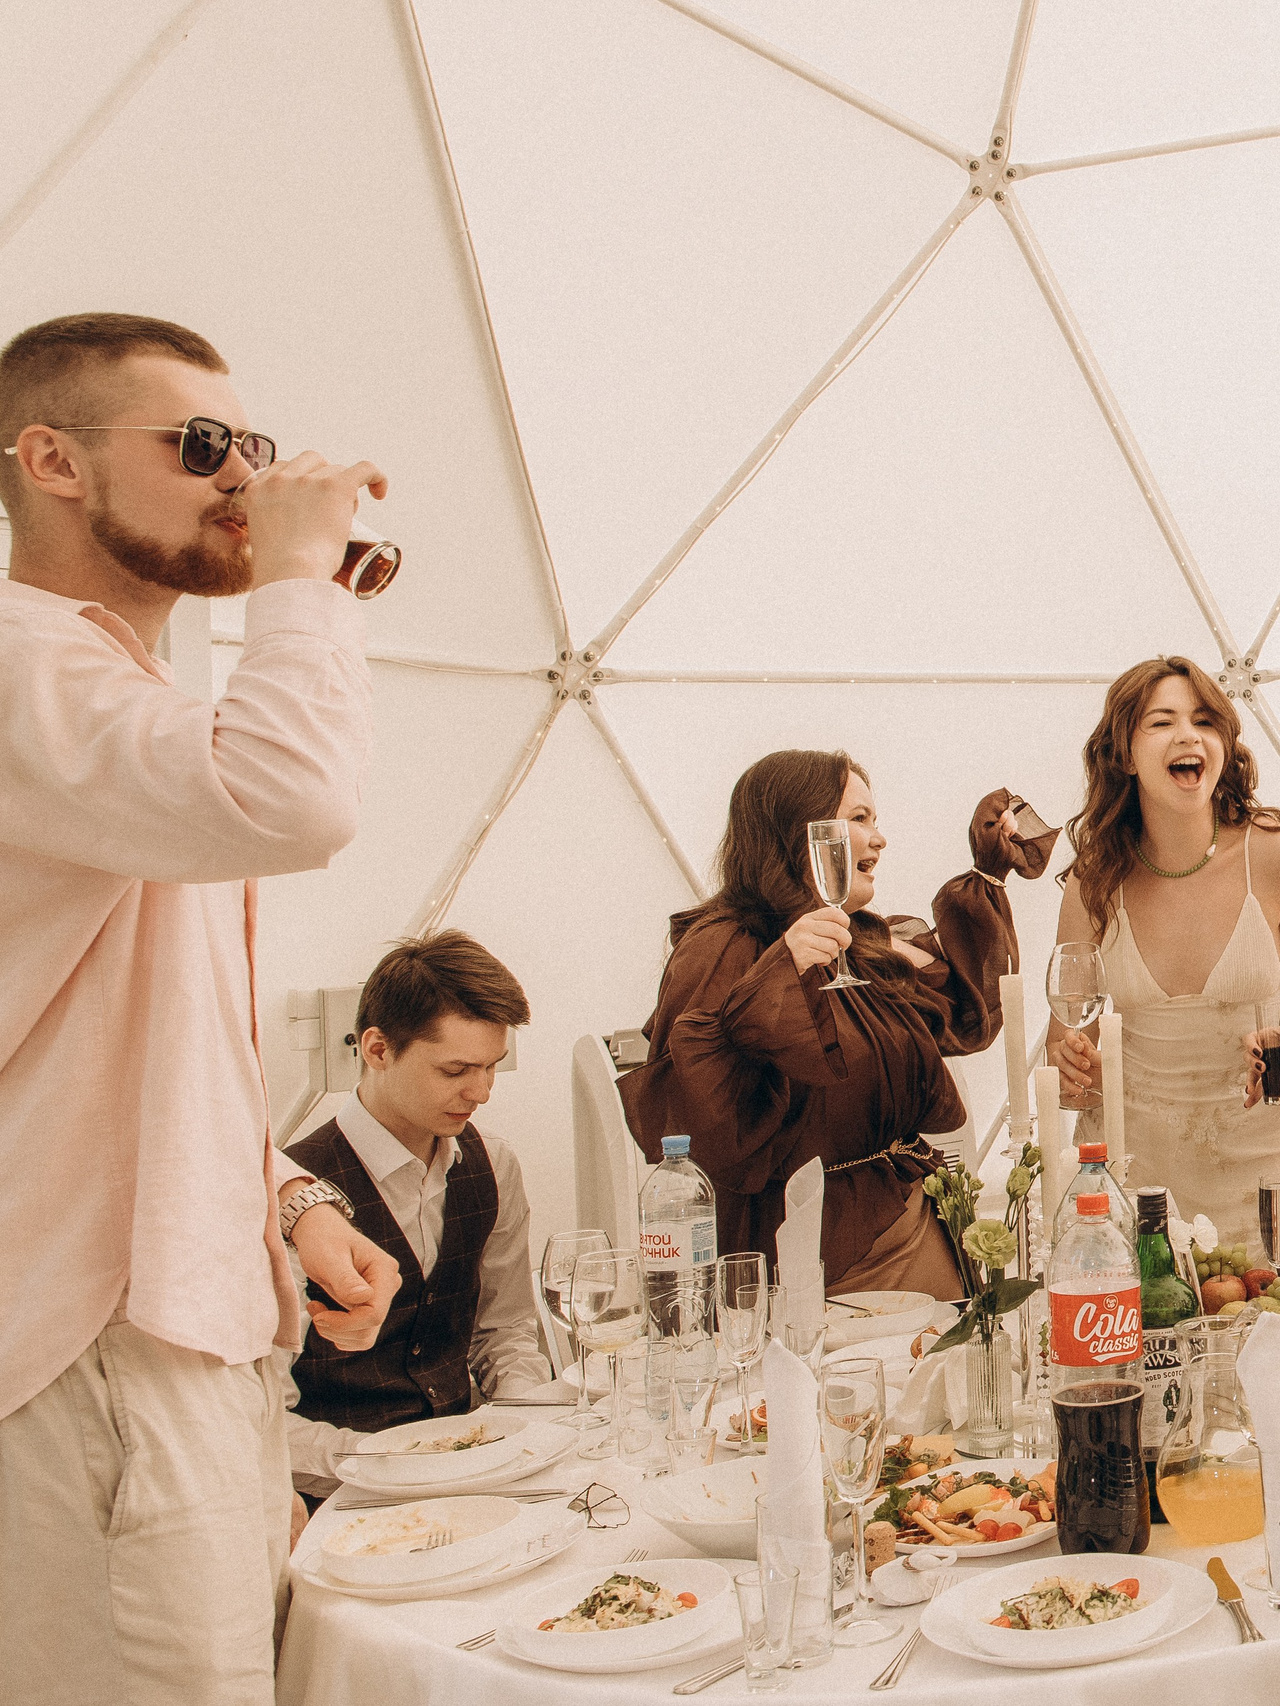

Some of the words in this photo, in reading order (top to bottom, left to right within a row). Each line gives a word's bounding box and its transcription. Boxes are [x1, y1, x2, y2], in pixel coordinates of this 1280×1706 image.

[1073, 1302, 1139, 1342] Cola
[1088, 1333, 1139, 1354] classic
[1144, 1373, 1162, 1383] NDED
[1162, 1370, 1183, 1379] SCOTC
